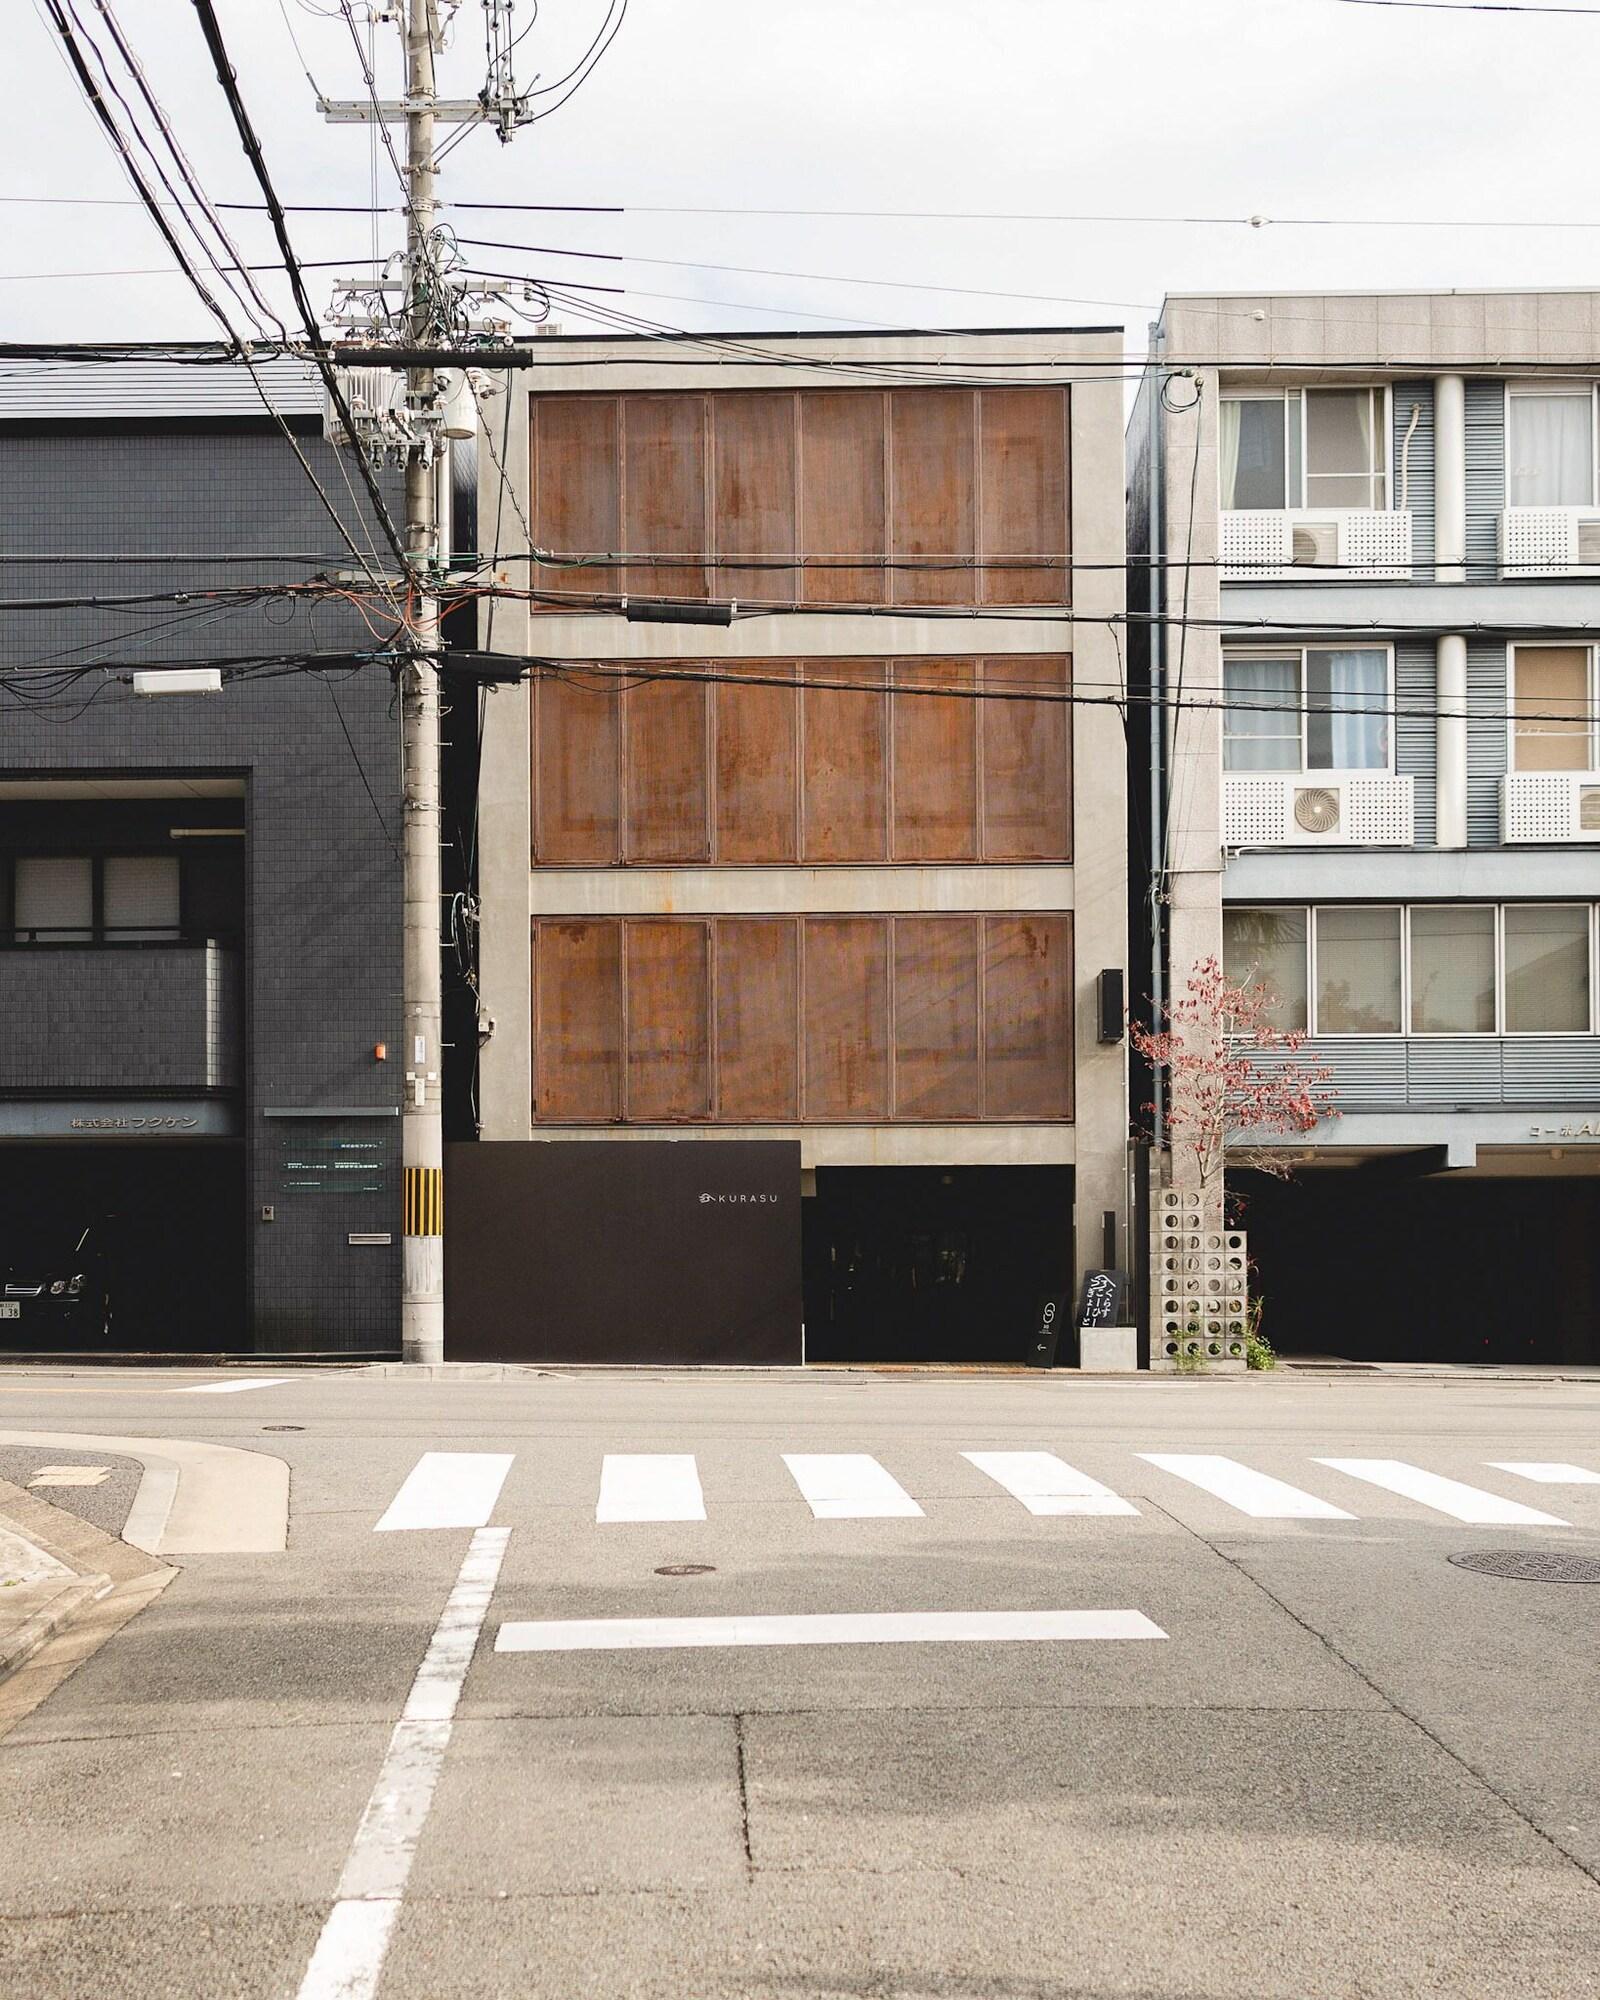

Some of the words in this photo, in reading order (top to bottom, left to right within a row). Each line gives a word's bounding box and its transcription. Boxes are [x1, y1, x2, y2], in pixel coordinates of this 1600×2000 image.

[71, 1116, 199, 1128] 株式会社フクケン
[718, 1194, 778, 1203] KURASU
[1101, 1288, 1114, 1318] くらす
